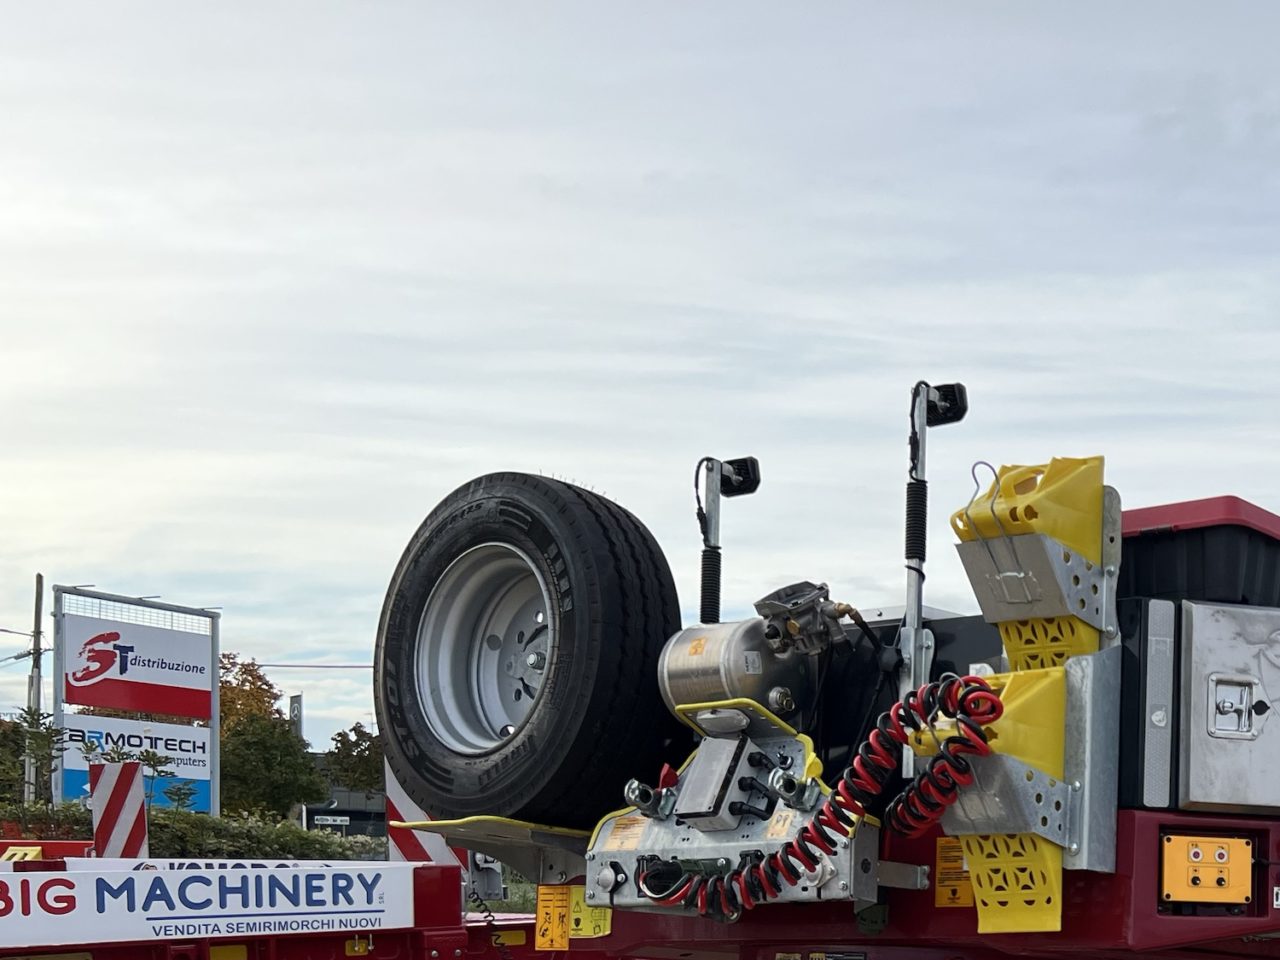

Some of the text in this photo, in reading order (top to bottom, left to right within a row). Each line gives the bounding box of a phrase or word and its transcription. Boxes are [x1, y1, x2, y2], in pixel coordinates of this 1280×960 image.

[129, 655, 206, 675] distribuzione
[96, 873, 382, 914] MACHINERY
[152, 917, 382, 937] VENDITA SEMIRIMORCHI NUOVI
